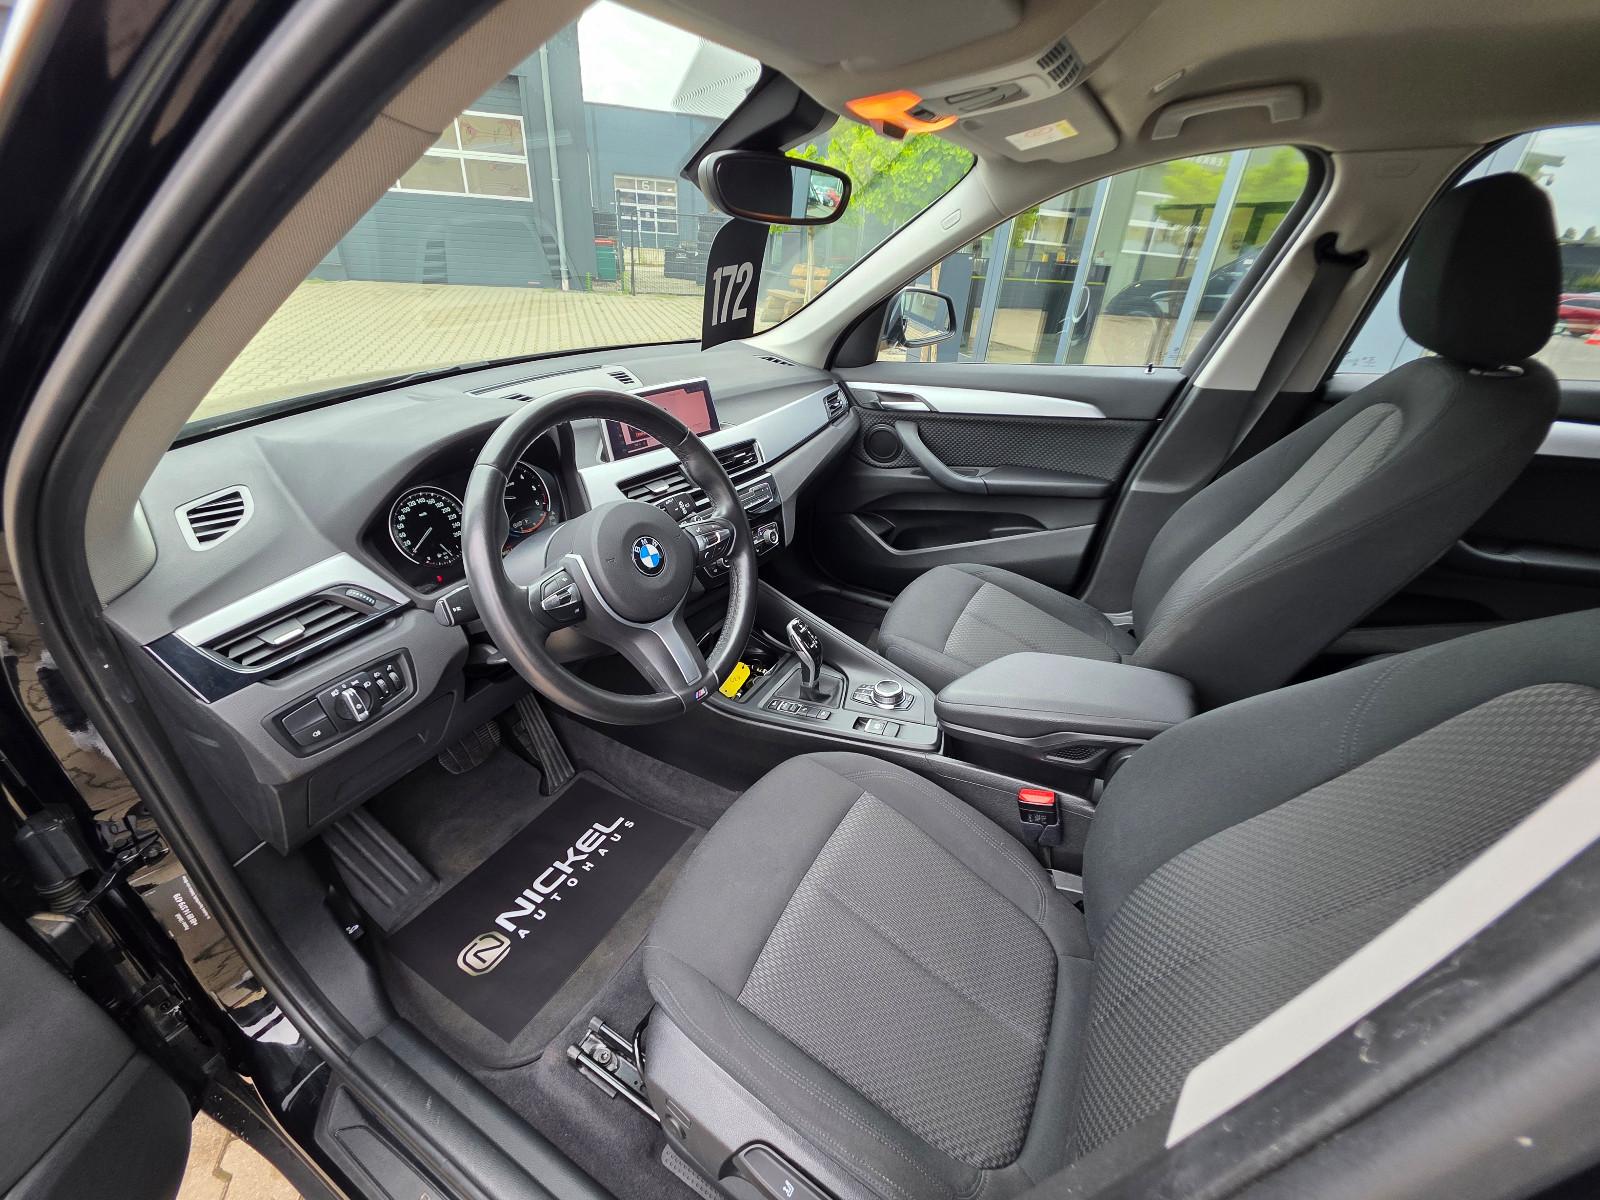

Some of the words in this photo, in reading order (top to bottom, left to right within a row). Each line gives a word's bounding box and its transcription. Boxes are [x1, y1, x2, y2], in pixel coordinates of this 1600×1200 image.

[711, 261, 754, 327] 172
[495, 816, 625, 933] NICKEL
[518, 819, 635, 939] AUTOHAUS
